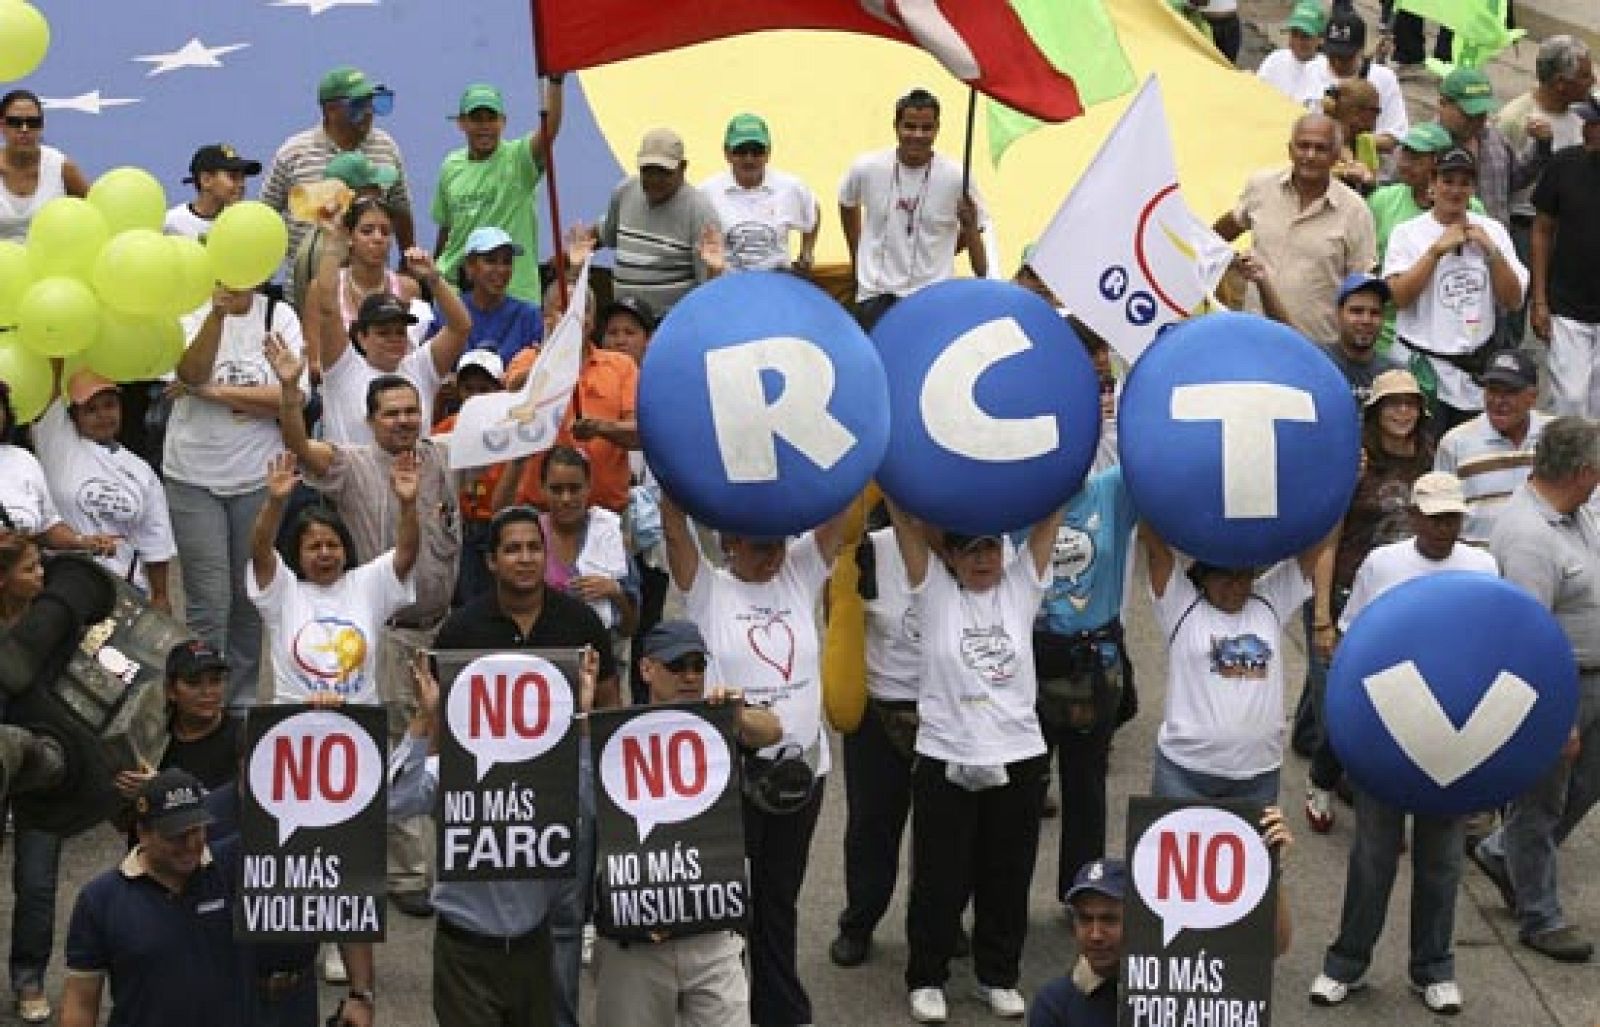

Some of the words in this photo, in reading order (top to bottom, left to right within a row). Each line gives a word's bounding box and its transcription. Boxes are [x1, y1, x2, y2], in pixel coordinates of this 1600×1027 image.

[705, 336, 859, 484] R
[919, 316, 1060, 461] C
[1170, 381, 1318, 519] T
[1361, 660, 1539, 788] V
[469, 672, 550, 739] NO
[272, 733, 358, 803] NO
[622, 729, 708, 800] NO
[444, 789, 475, 823] NO
[482, 780, 535, 822] MÁS
[243, 854, 277, 888] NO
[284, 847, 342, 888] MÁS
[444, 824, 571, 870] FARC
[607, 854, 640, 886] NO
[648, 840, 702, 882] MÁS
[1157, 830, 1246, 904] NO
[243, 895, 379, 932] VIOLENCIA
[610, 881, 745, 925] INSULTOS
[1128, 954, 1160, 990] NO
[1169, 948, 1225, 992] MÁS
